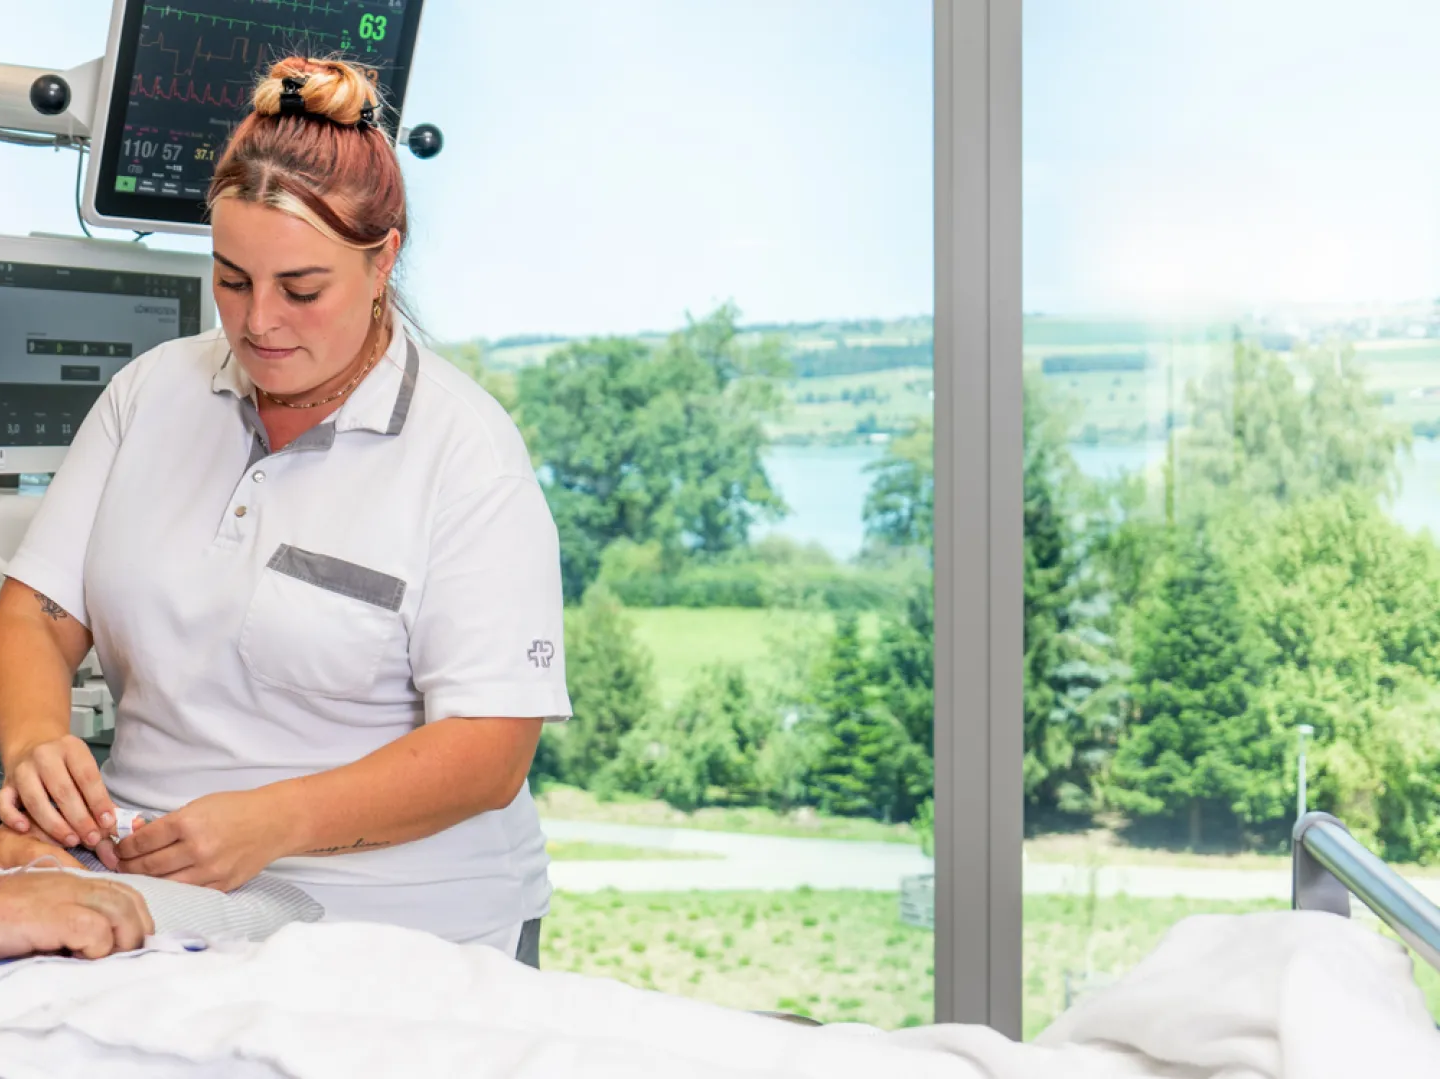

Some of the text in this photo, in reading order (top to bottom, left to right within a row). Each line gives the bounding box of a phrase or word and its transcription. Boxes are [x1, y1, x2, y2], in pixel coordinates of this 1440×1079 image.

[359, 12, 387, 41] 63
[162, 144, 183, 161] 57
[193, 147, 215, 161] 37.1
